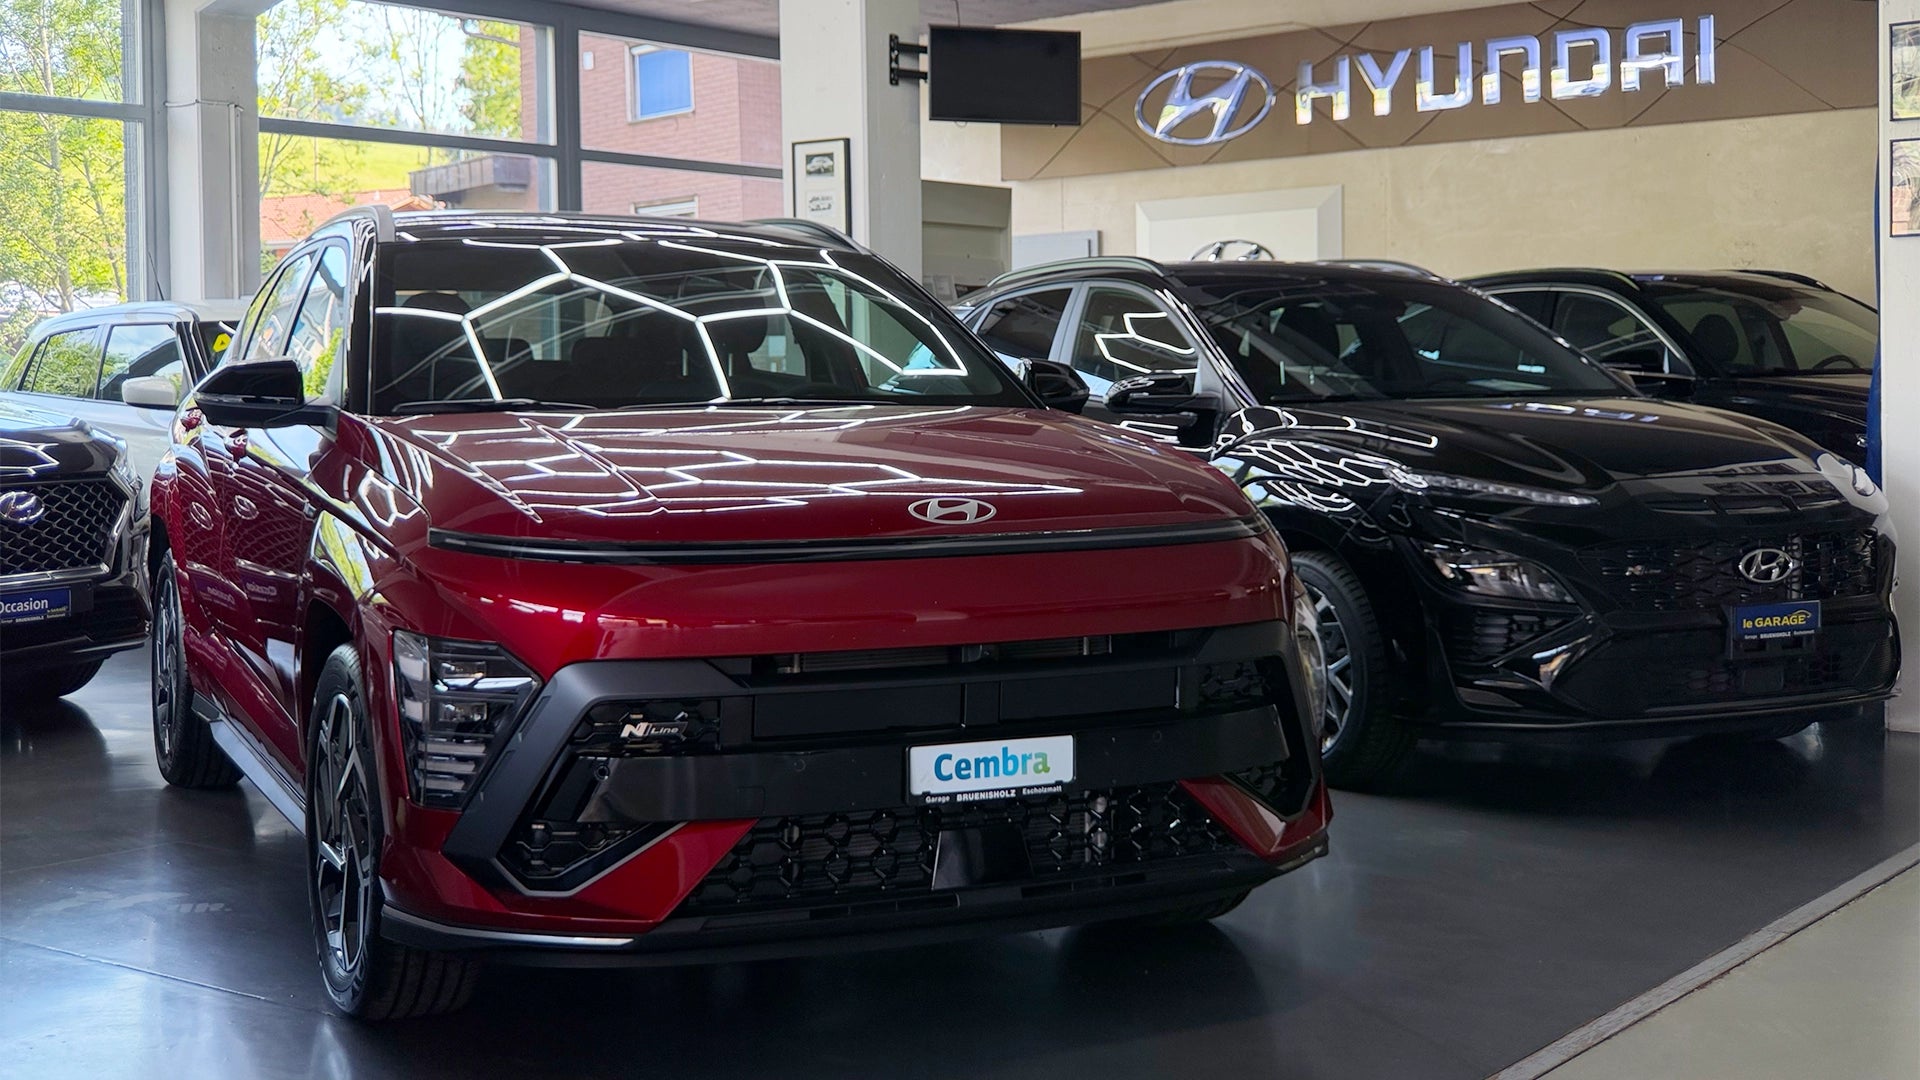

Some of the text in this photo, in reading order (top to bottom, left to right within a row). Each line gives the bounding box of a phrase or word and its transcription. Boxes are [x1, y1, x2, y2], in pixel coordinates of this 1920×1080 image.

[1295, 14, 1715, 125] HYUNDAI
[1743, 614, 1806, 629] le GARAGE
[934, 746, 1051, 781] Cembra
[925, 785, 1062, 804] Garage BRUENISHOLZ Escholzmatt
